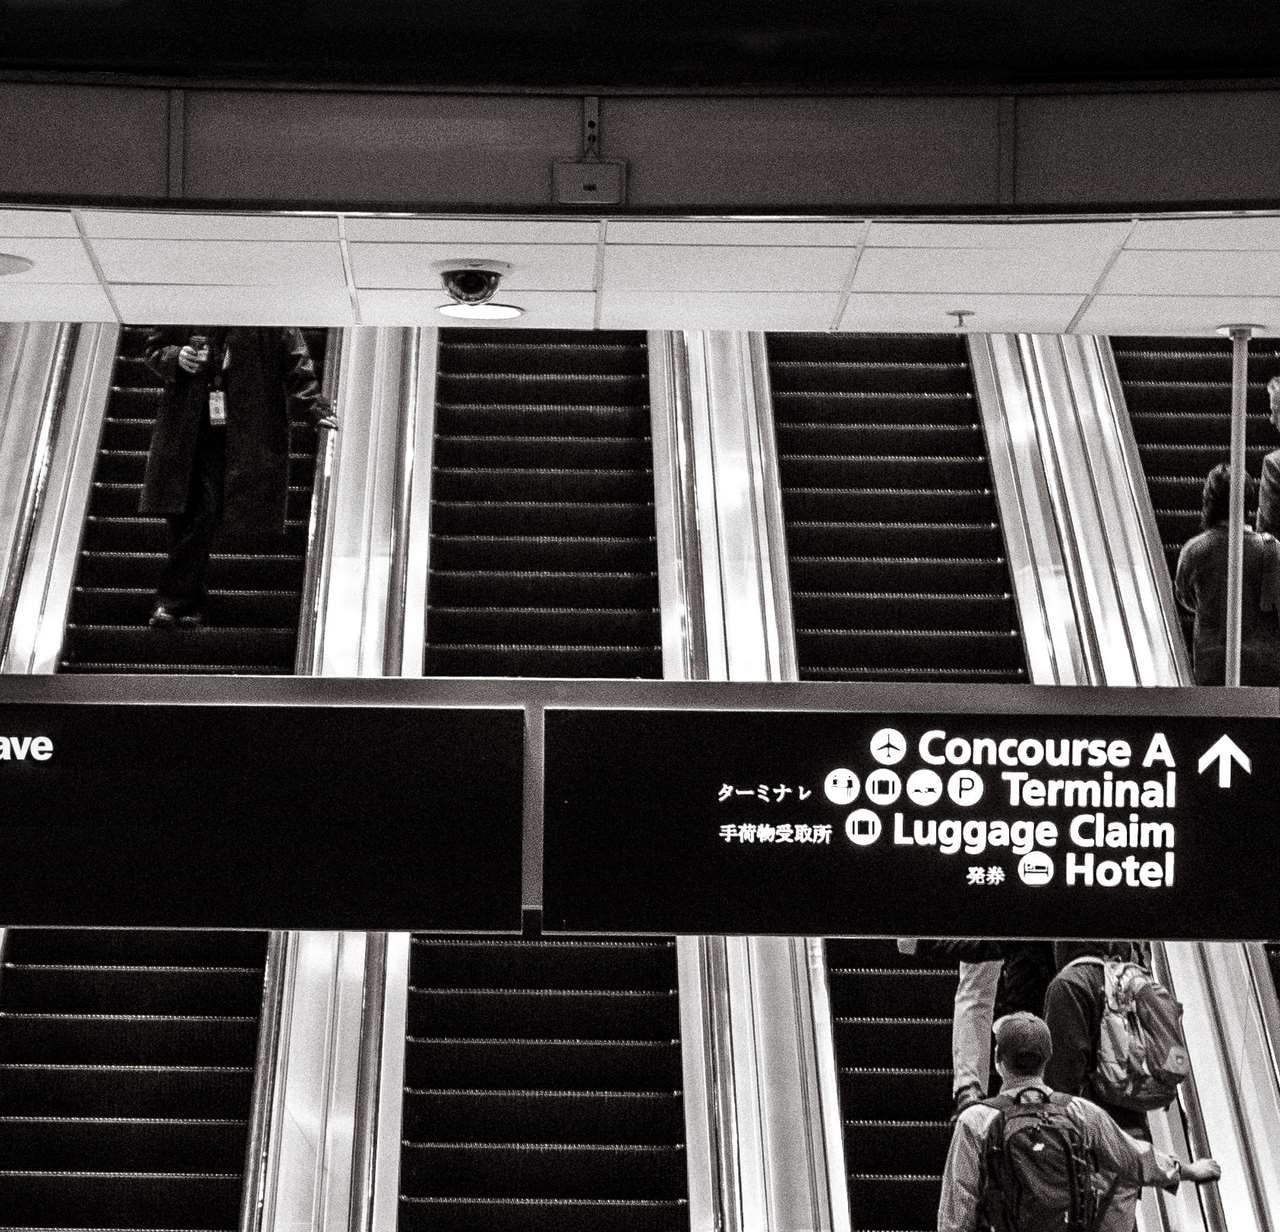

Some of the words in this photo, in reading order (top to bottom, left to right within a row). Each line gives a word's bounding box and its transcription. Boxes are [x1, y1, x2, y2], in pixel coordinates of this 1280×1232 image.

[918, 729, 1132, 768] Concourse
[1141, 732, 1176, 768] A
[1000, 770, 1177, 808] Terminal
[718, 822, 833, 845] 手荷物受取所
[893, 812, 1059, 855] Luggage
[1069, 812, 1175, 849] Claim
[1065, 851, 1175, 888] Hotel
